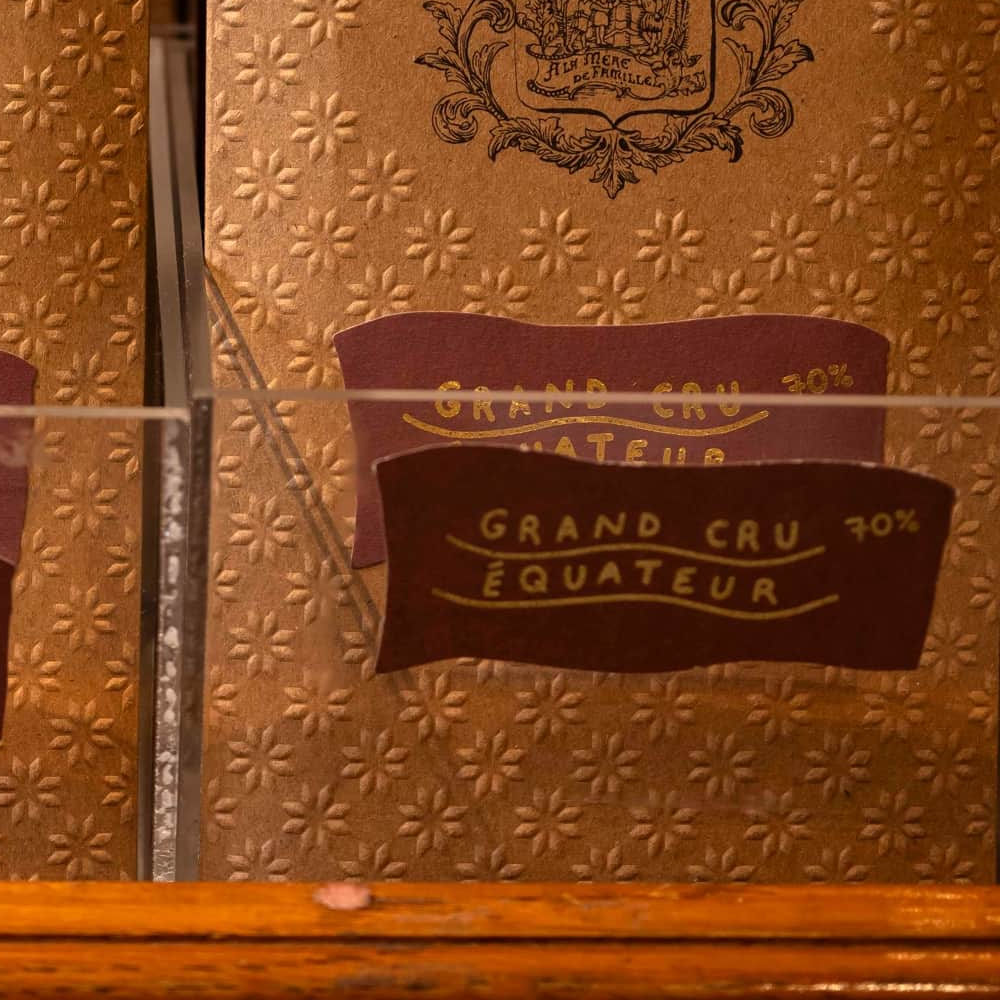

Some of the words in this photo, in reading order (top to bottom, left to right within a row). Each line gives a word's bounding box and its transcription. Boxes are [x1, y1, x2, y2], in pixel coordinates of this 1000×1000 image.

[592, 66, 651, 85] FAMILLE
[435, 378, 608, 422] GRAND
[652, 380, 741, 421] CRU
[479, 508, 662, 546] GRAND
[704, 519, 800, 553] CRU
[843, 508, 921, 543] 70%
[482, 560, 778, 606] ÉQUATEUR
